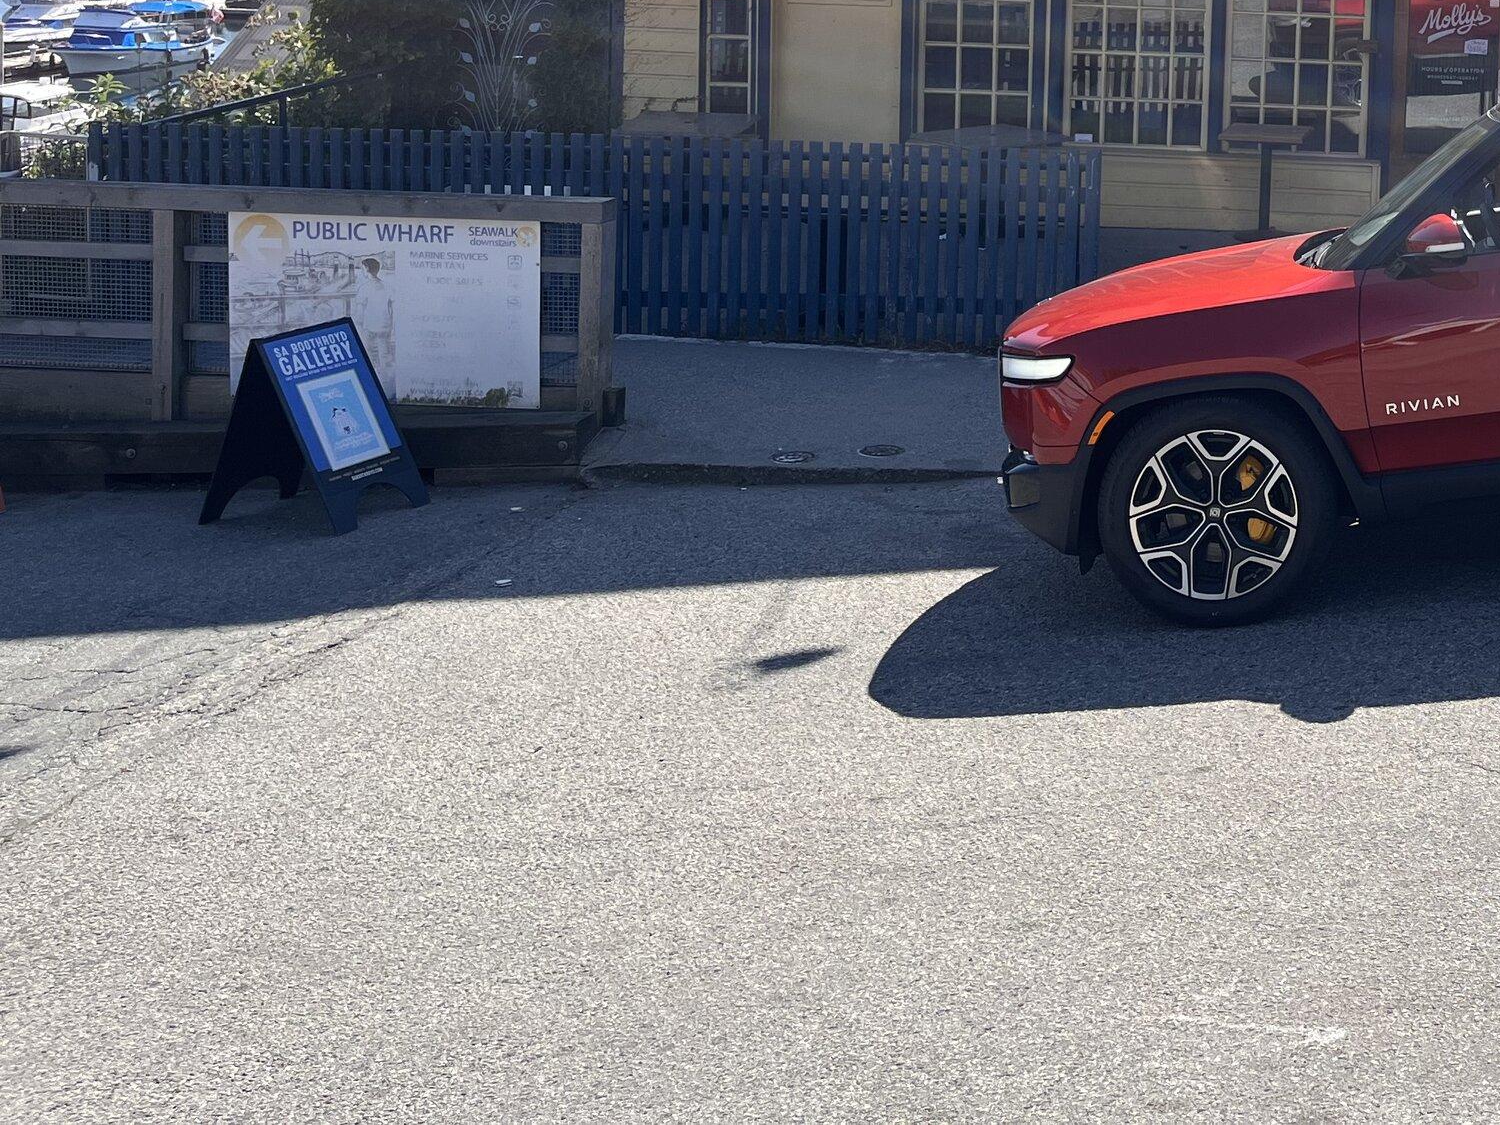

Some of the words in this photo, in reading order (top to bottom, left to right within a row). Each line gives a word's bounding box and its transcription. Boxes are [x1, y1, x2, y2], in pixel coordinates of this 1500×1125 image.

[1418, 3, 1492, 36] Molly's
[292, 220, 367, 241] PUBLIC
[376, 223, 455, 244] WHARF
[468, 226, 518, 239] SEAWALK
[470, 238, 518, 248] downstairs
[410, 251, 445, 260] MARINE
[447, 252, 489, 261] SERVICES
[410, 261, 442, 269] WATER
[445, 261, 465, 270] TAXI
[273, 346, 290, 358] SA
[290, 331, 348, 354] BOOTHROYD
[278, 340, 354, 376] GALLERY
[1385, 394, 1461, 416] RIVIAN
